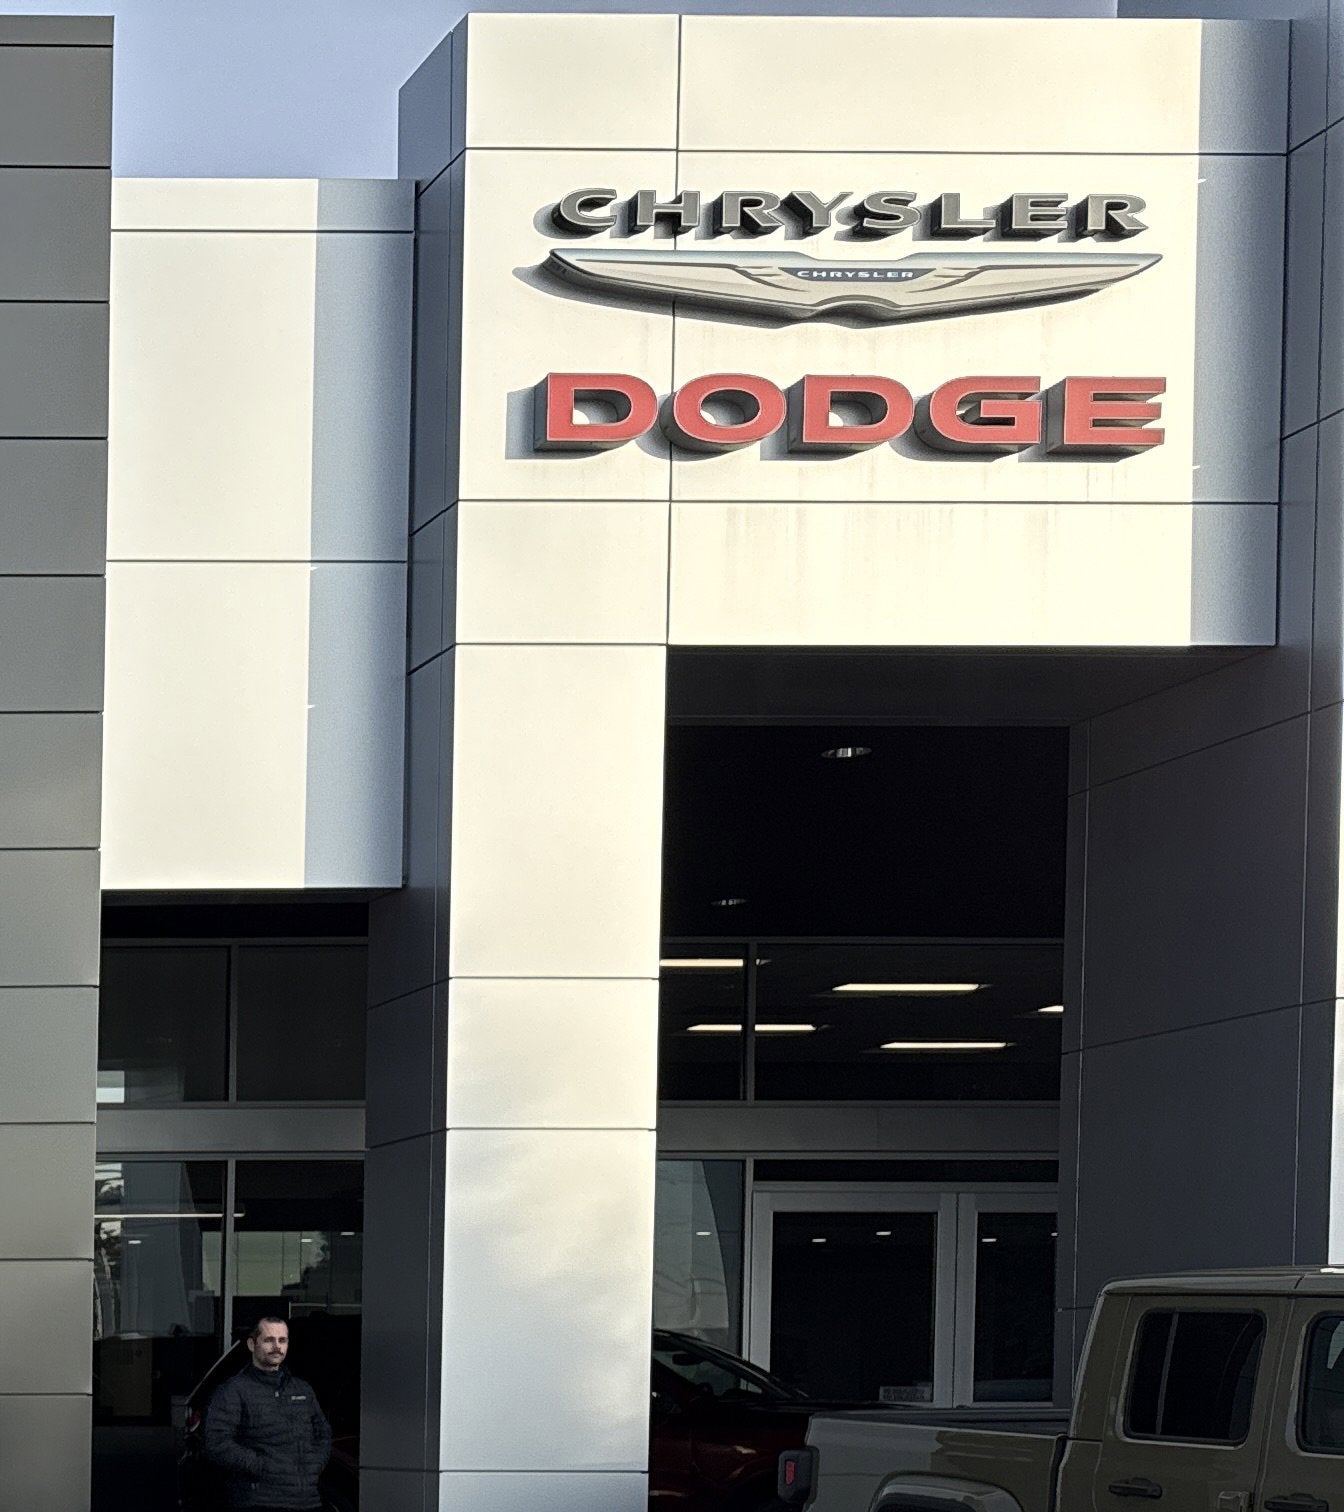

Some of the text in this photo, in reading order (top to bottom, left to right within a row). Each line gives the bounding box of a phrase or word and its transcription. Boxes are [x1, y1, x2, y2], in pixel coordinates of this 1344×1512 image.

[549, 186, 1150, 238] CHRYSLER
[796, 269, 915, 279] CHRYSLER
[538, 371, 1168, 448] DODGE
